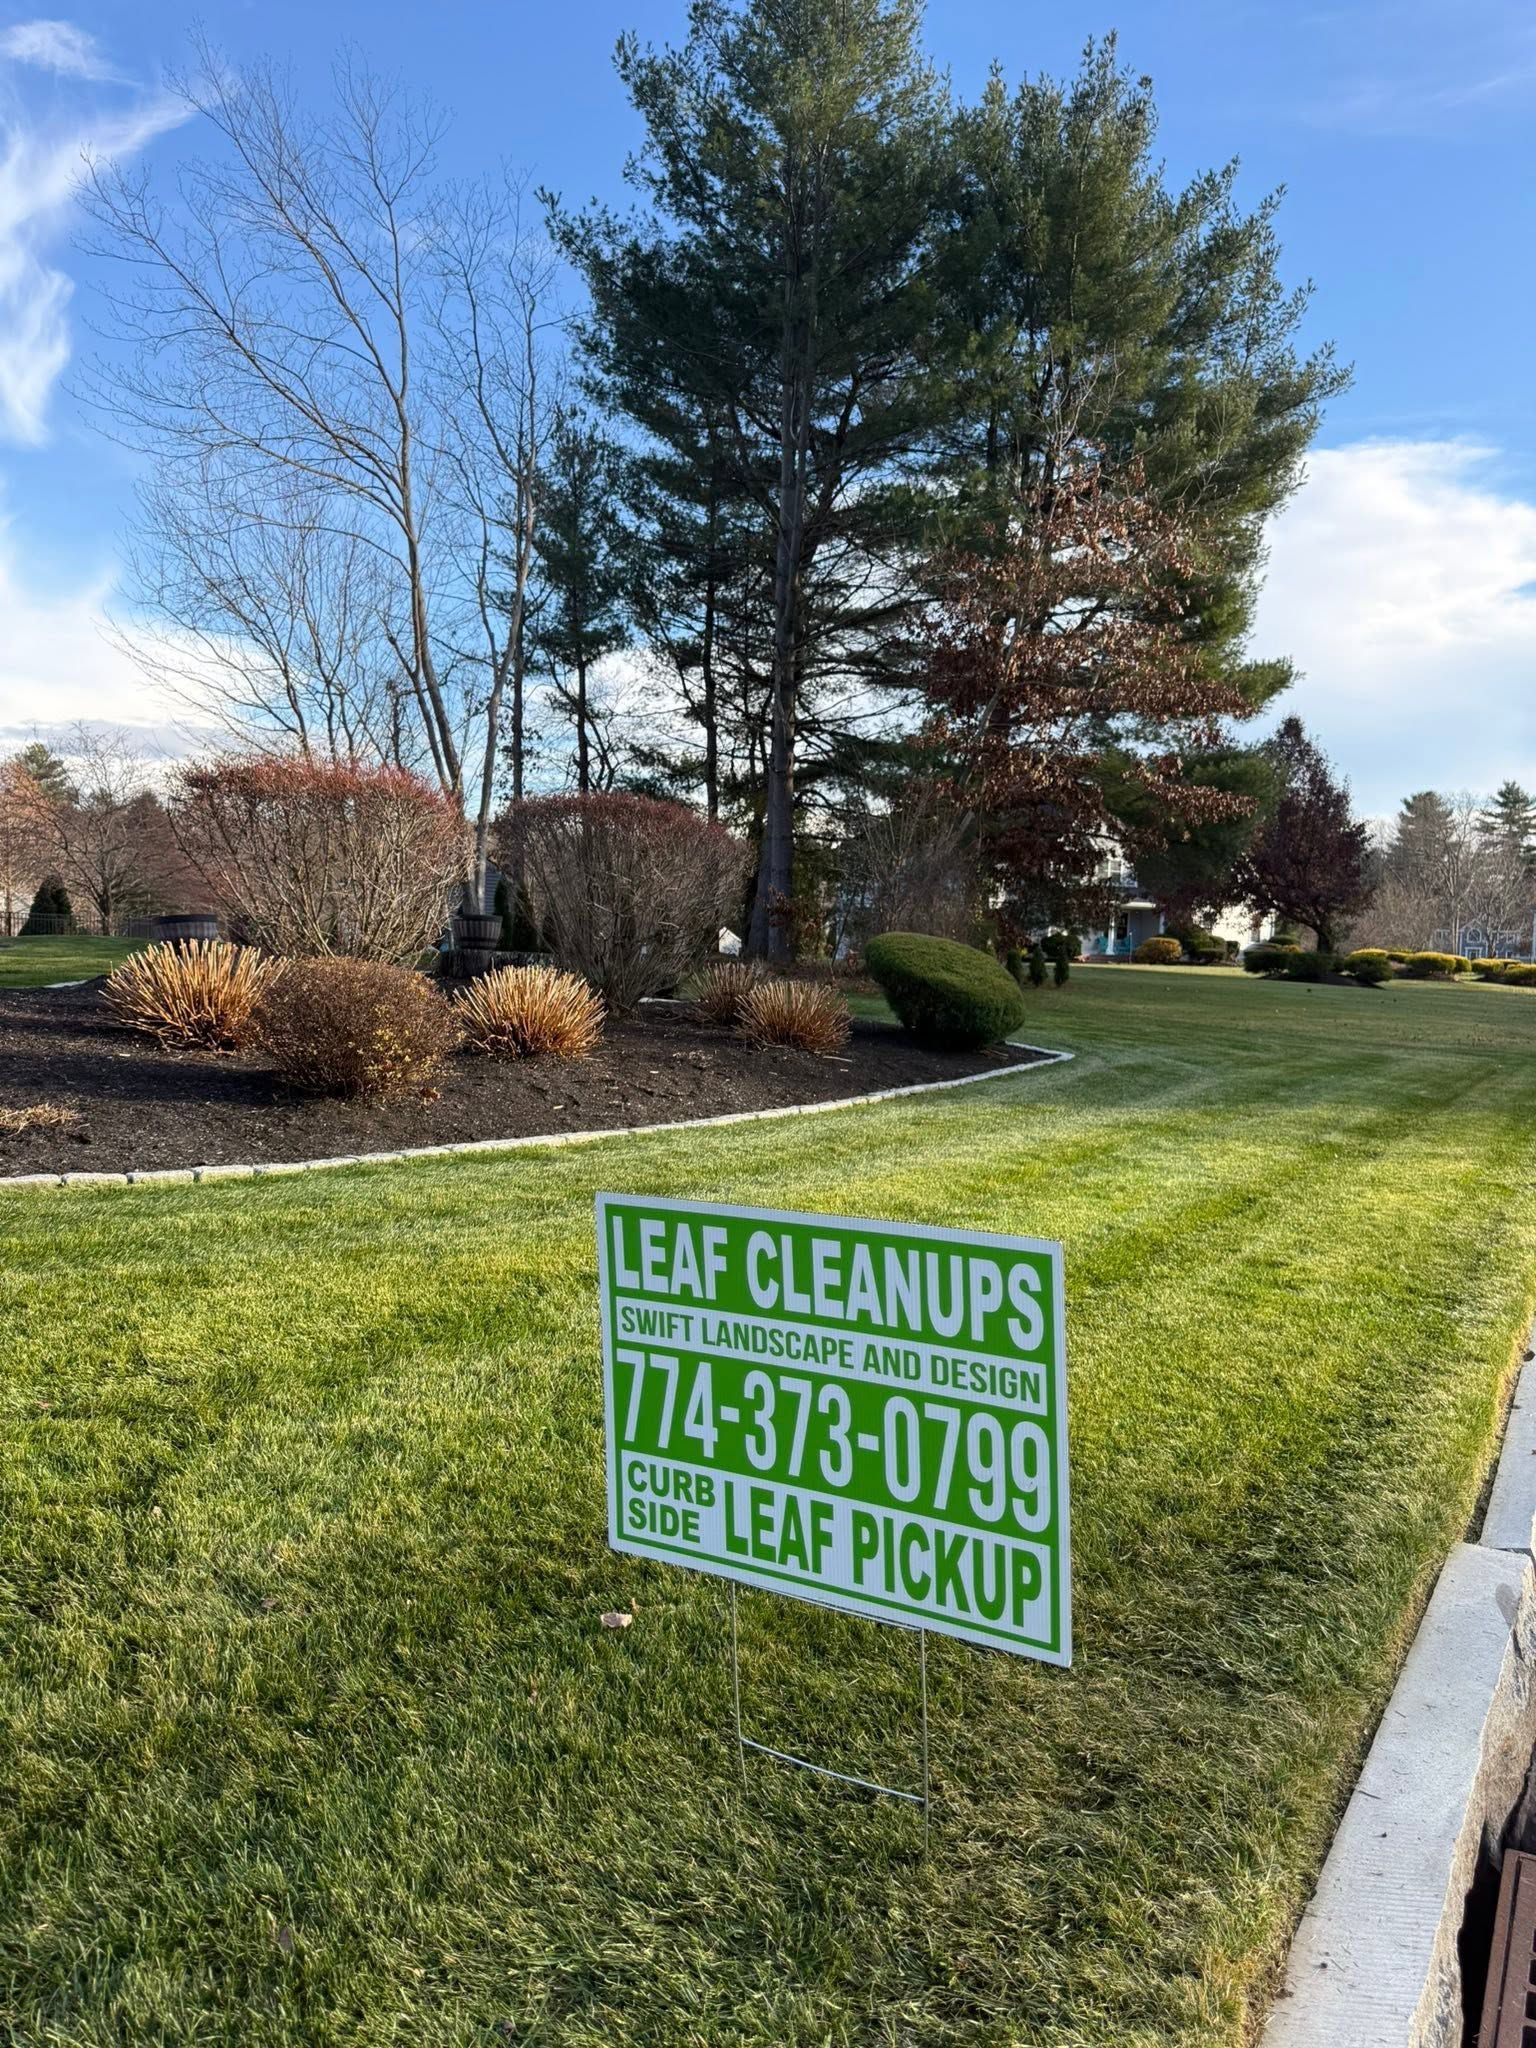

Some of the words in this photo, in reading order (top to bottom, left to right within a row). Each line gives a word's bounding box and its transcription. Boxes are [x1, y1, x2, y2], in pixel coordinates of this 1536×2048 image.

[612, 1215, 728, 1300] LEAF
[746, 1230, 1045, 1352] CLEANUPS
[621, 1305, 695, 1340] SWIFT
[701, 1318, 854, 1370] LANDSCAPE
[863, 1344, 921, 1380] AND
[931, 1355, 1041, 1404] DESIGN
[616, 1348, 1051, 1533] 774-373-0799
[627, 1460, 716, 1507] CURB
[627, 1497, 700, 1543] SIDE
[724, 1480, 834, 1574] LEAF
[852, 1509, 1043, 1628] PICKUP
